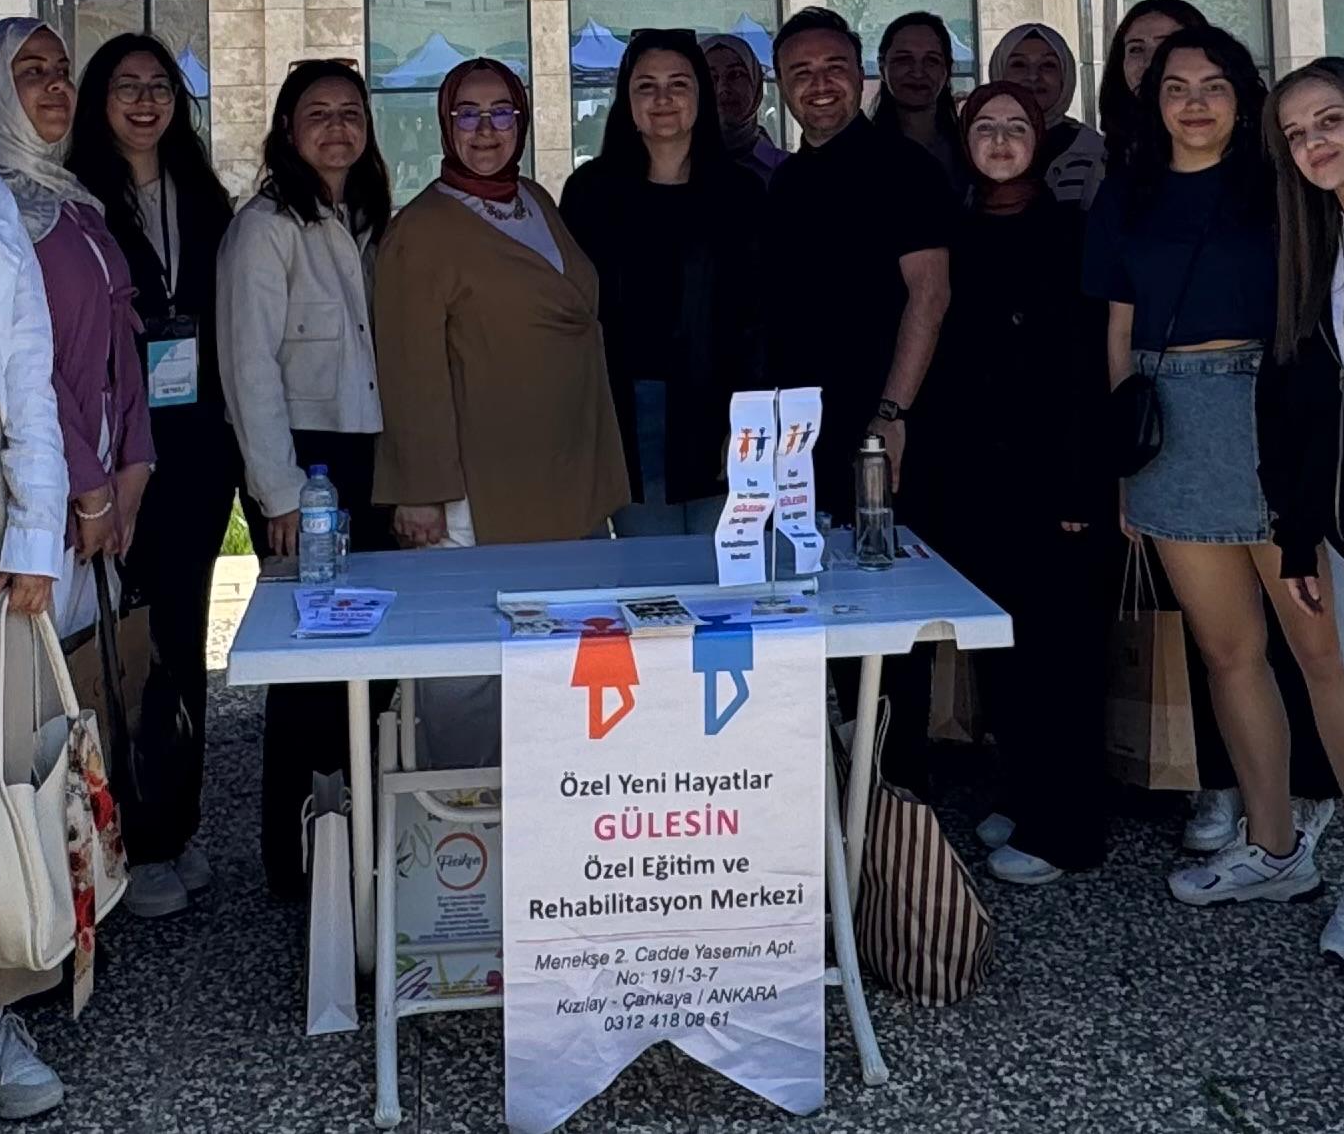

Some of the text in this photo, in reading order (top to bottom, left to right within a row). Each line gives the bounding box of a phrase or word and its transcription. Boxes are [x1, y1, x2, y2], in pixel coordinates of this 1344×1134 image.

[560, 769, 774, 797] Özel Yeni Hayatlar
[594, 803, 739, 841] GÜLESİN
[584, 854, 750, 881] Özel Eğitim ve
[529, 882, 804, 920] Rehabilitasyon Merkezi
[534, 949, 610, 971] Menekşe
[635, 944, 690, 963] Cadde
[695, 941, 762, 960] Yasemin
[765, 939, 796, 960] Apt.
[616, 966, 719, 986] No: 19/1-3-7
[556, 995, 606, 1015] Kızılay
[622, 990, 692, 1012] Çankaya
[707, 984, 778, 1004] ANKARA
[604, 1010, 730, 1032] 0312 418 08 61
